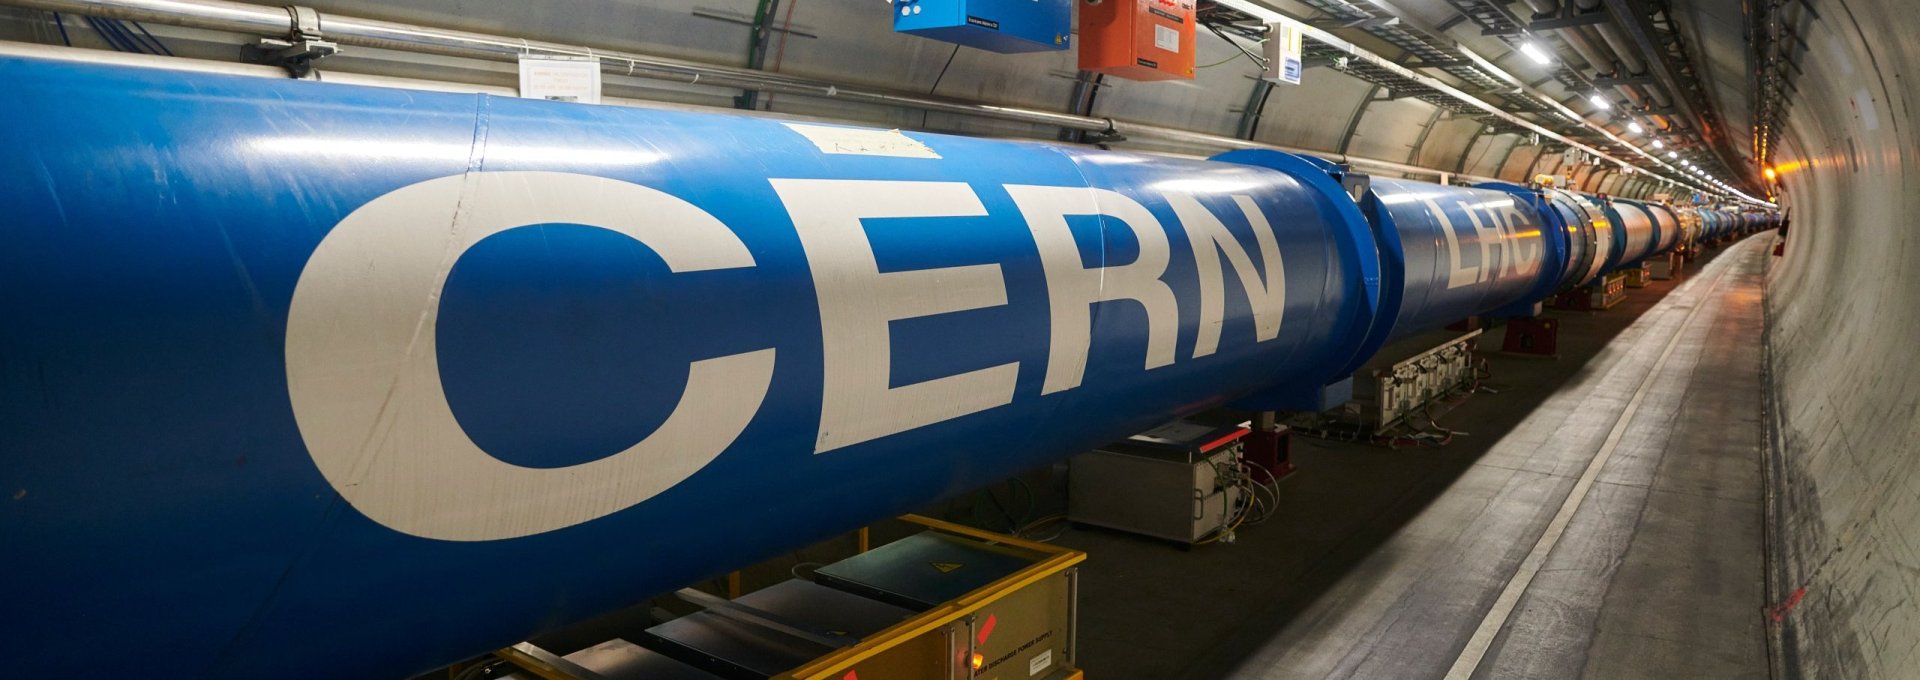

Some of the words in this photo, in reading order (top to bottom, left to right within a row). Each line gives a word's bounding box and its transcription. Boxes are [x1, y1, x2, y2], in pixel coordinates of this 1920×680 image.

[1424, 199, 1544, 289] LHC
[286, 171, 1287, 541] CERN
[974, 666, 988, 677] ATER
[988, 650, 1017, 669] DISCHARGE
[1018, 639, 1035, 653] POWER
[1035, 630, 1053, 643] SUPPLY
